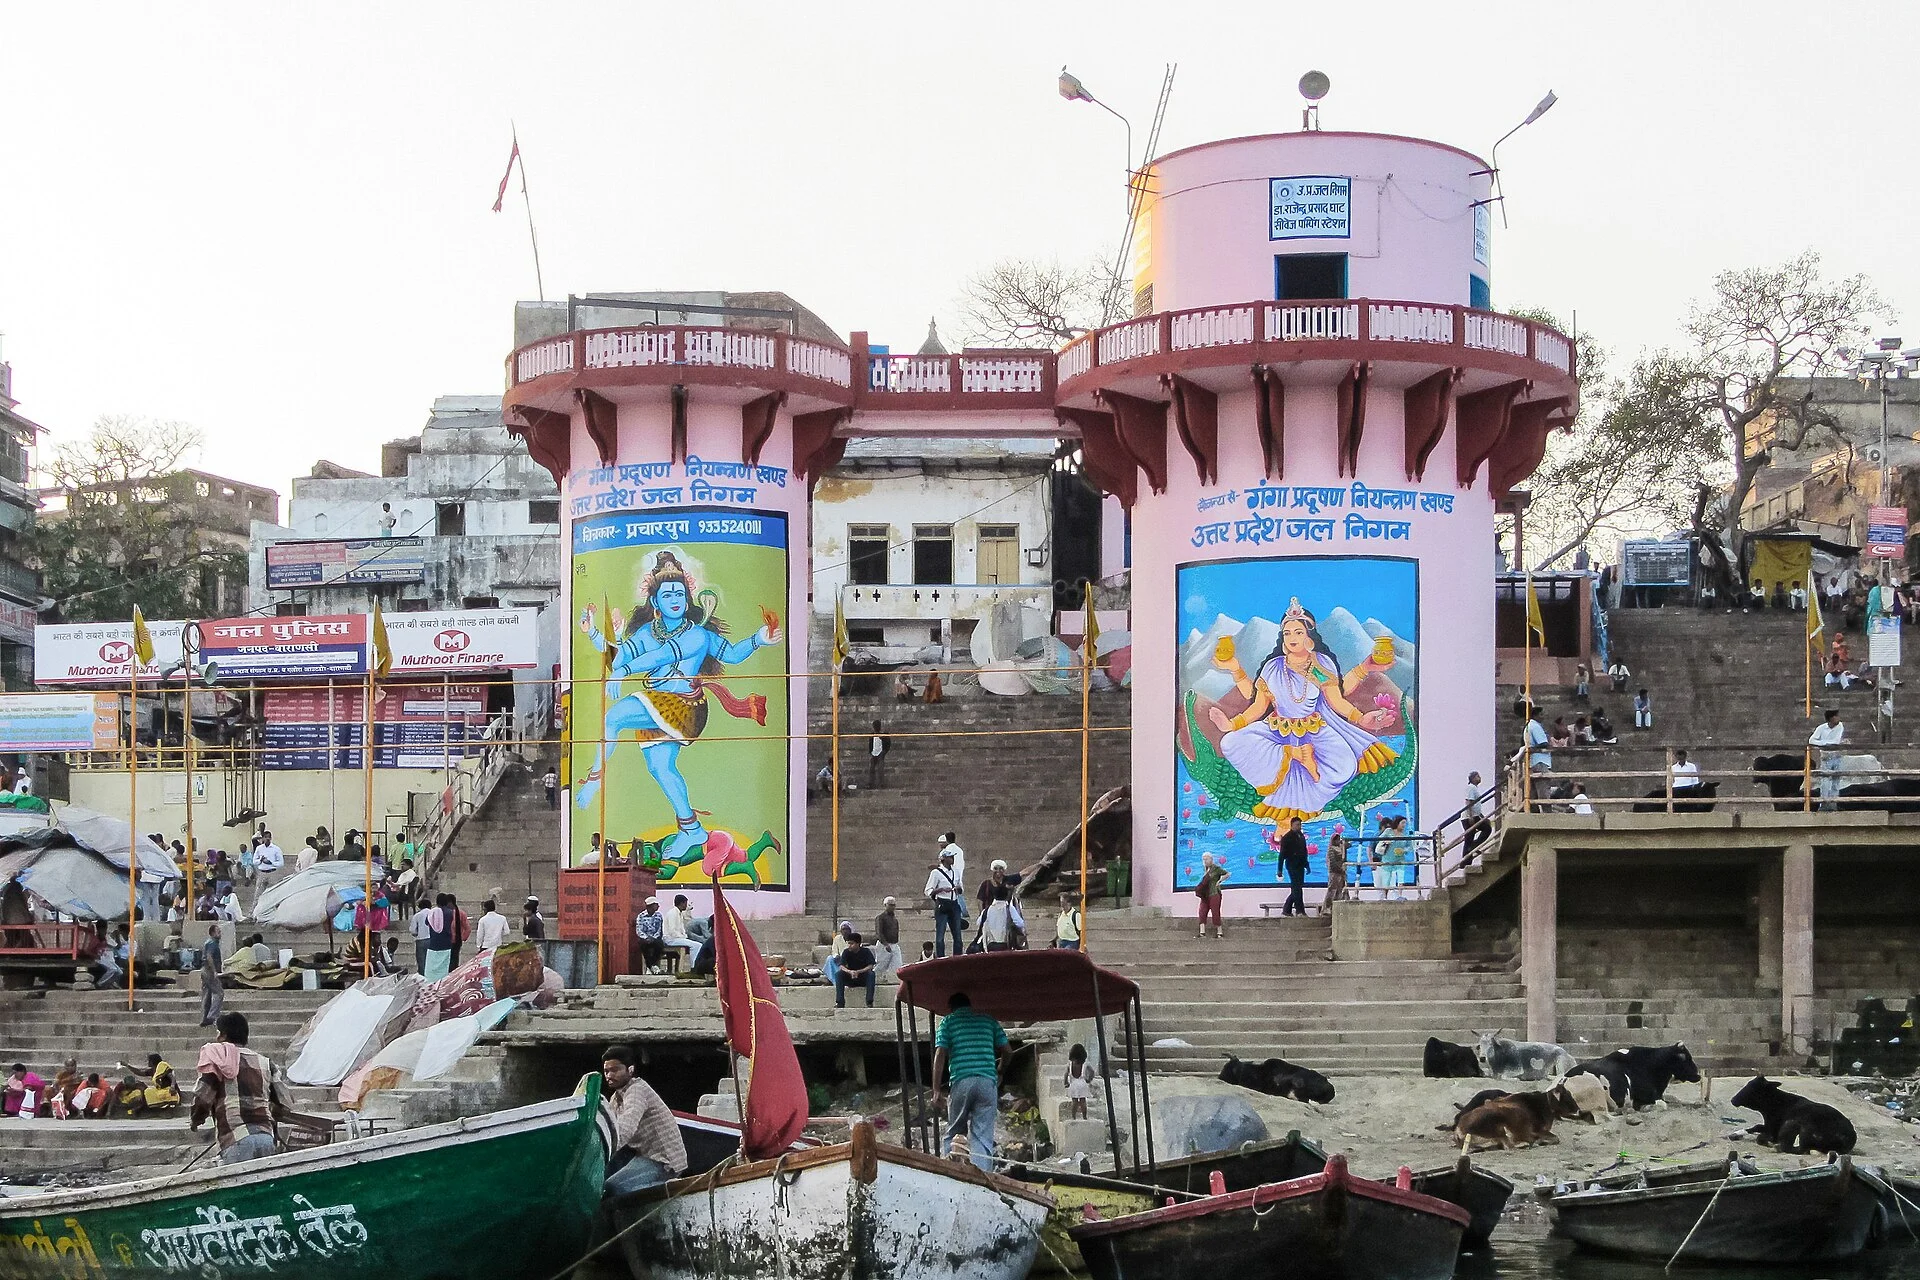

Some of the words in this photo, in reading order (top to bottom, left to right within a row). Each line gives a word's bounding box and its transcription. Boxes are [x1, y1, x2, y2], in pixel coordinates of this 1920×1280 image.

[1308, 203, 1328, 213] प्रसाद
[1330, 203, 1345, 213] घाट
[1274, 218, 1296, 230] सीवेज
[1321, 217, 1346, 228] स्टेशन
[618, 462, 671, 486] प्रदूषण
[756, 465, 788, 488] खण्ड
[595, 485, 636, 511] प्रदेश
[641, 487, 683, 505] जल
[690, 478, 757, 503] निगम
[1244, 479, 1290, 509] गंगा
[1291, 487, 1346, 514] प्रदूषण
[1420, 491, 1454, 514] खण्ड
[698, 520, 762, 534] 9335240111
[1191, 522, 1230, 547] उत्तर
[1234, 512, 1283, 545] प्रदेश
[1286, 519, 1335, 541] जल
[1343, 513, 1411, 540] निगम
[420, 618, 439, 628] सबसे
[457, 617, 477, 627] गोल्ड
[479, 616, 495, 626] लोन
[497, 615, 519, 625] कंपनी
[86, 629, 104, 640] सबसे
[214, 625, 264, 637] जल
[271, 620, 351, 640] पुलिस
[401, 655, 454, 665] Muthoot
[457, 653, 504, 664] Finance
[68, 665, 118, 676] Muthoot
[293, 1194, 367, 1258] तेल
